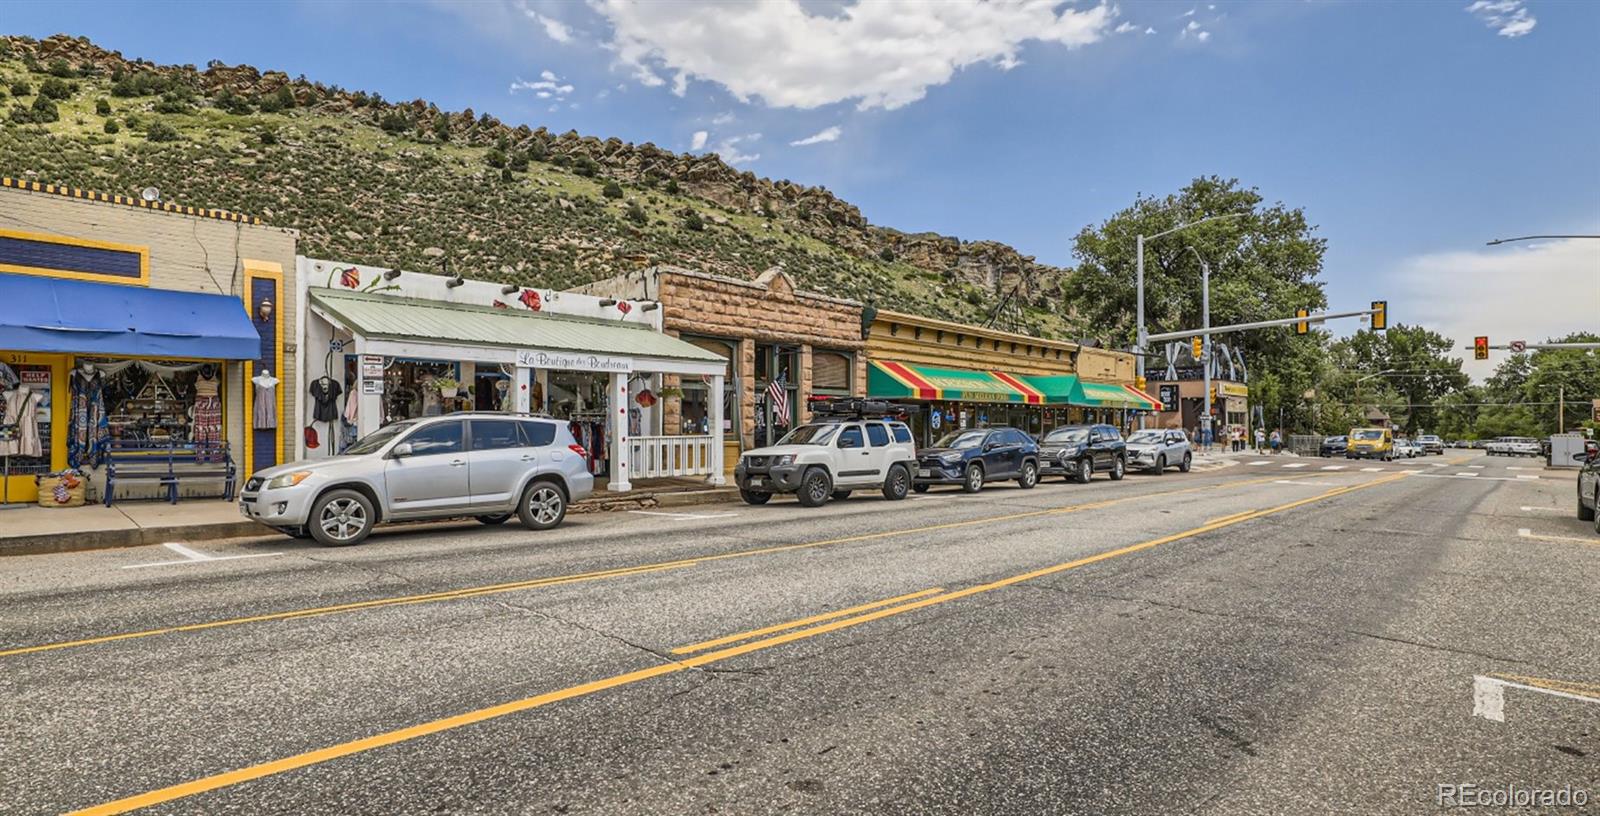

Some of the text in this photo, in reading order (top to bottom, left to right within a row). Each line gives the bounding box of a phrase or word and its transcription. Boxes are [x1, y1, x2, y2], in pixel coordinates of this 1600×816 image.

[10, 354, 26, 362] 311
[519, 351, 534, 366] La
[536, 352, 574, 368] Boutique
